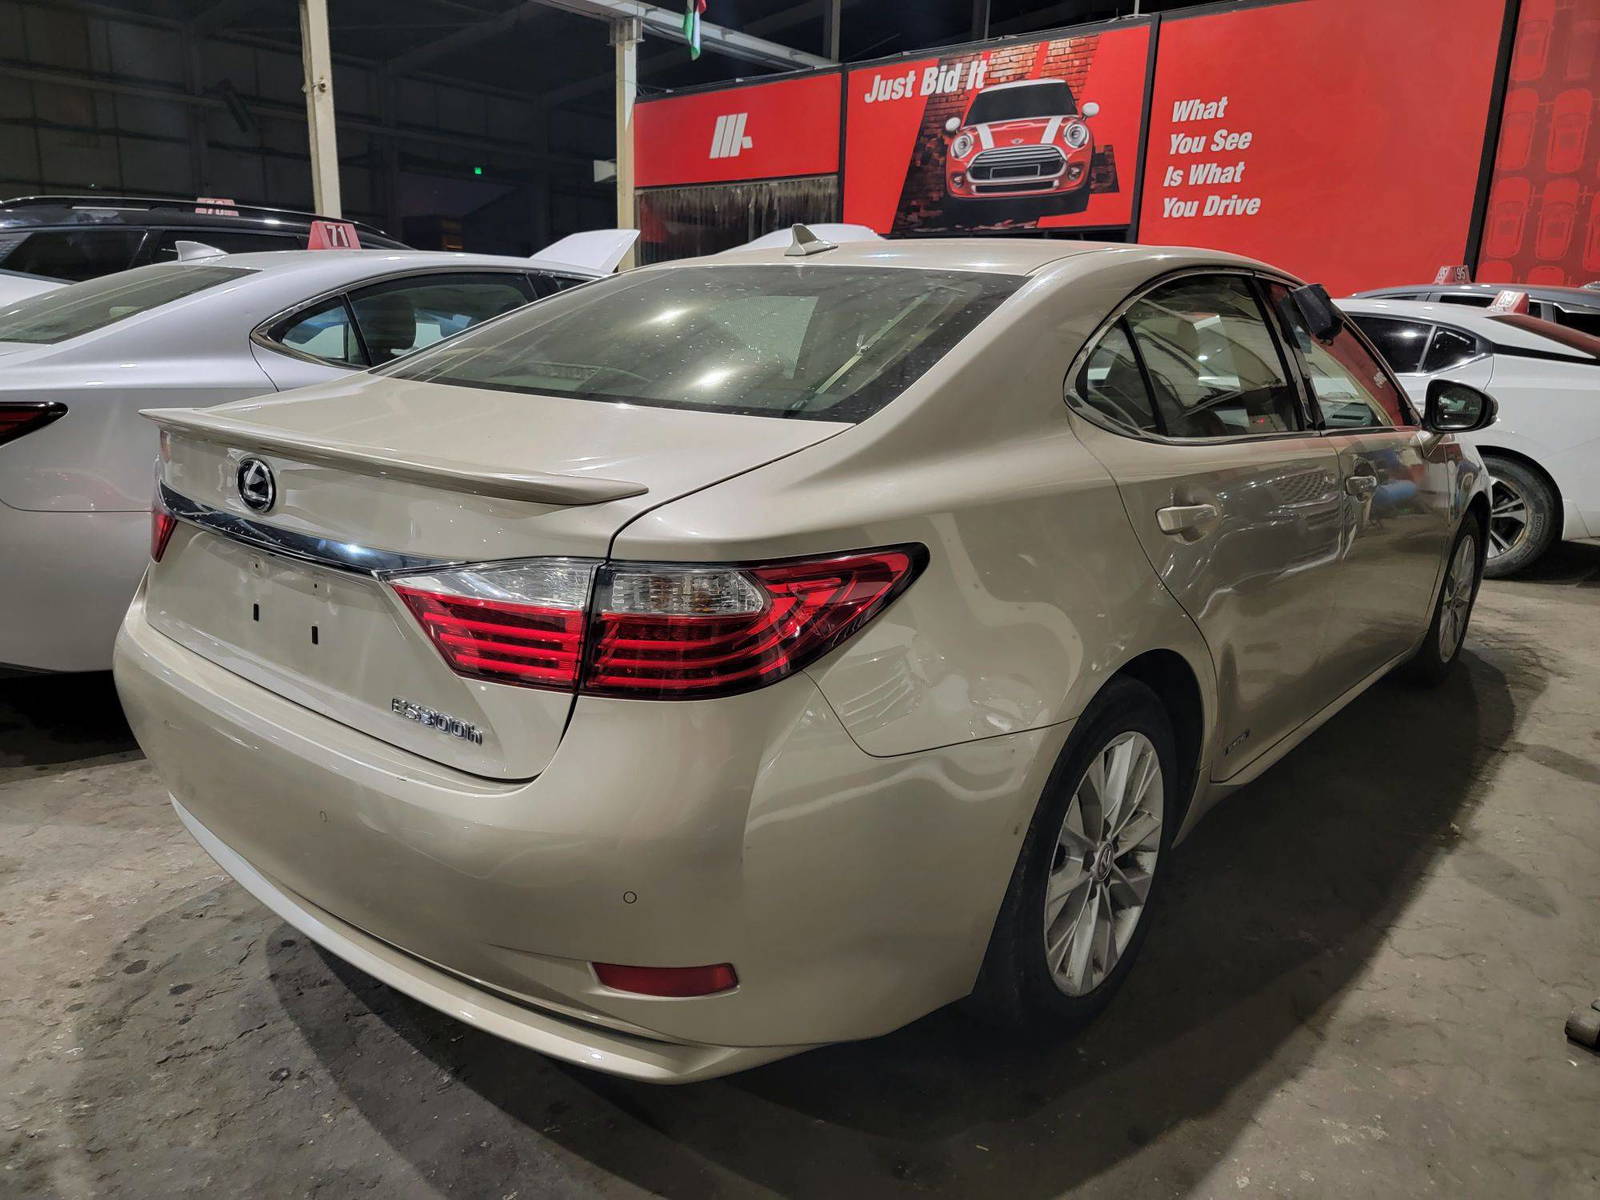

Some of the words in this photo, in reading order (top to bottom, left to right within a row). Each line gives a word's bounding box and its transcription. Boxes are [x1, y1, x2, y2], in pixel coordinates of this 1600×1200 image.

[864, 70, 916, 104] Just
[919, 63, 963, 97] Bid
[965, 59, 988, 91] It
[1172, 96, 1228, 123] What
[1169, 133, 1207, 155] You
[1210, 129, 1253, 152] See
[1163, 166, 1184, 187] Is
[1188, 161, 1246, 186] What
[1163, 197, 1199, 218] You
[1202, 194, 1261, 217] Drive
[326, 225, 349, 247] 71
[1456, 267, 1466, 280] 95
